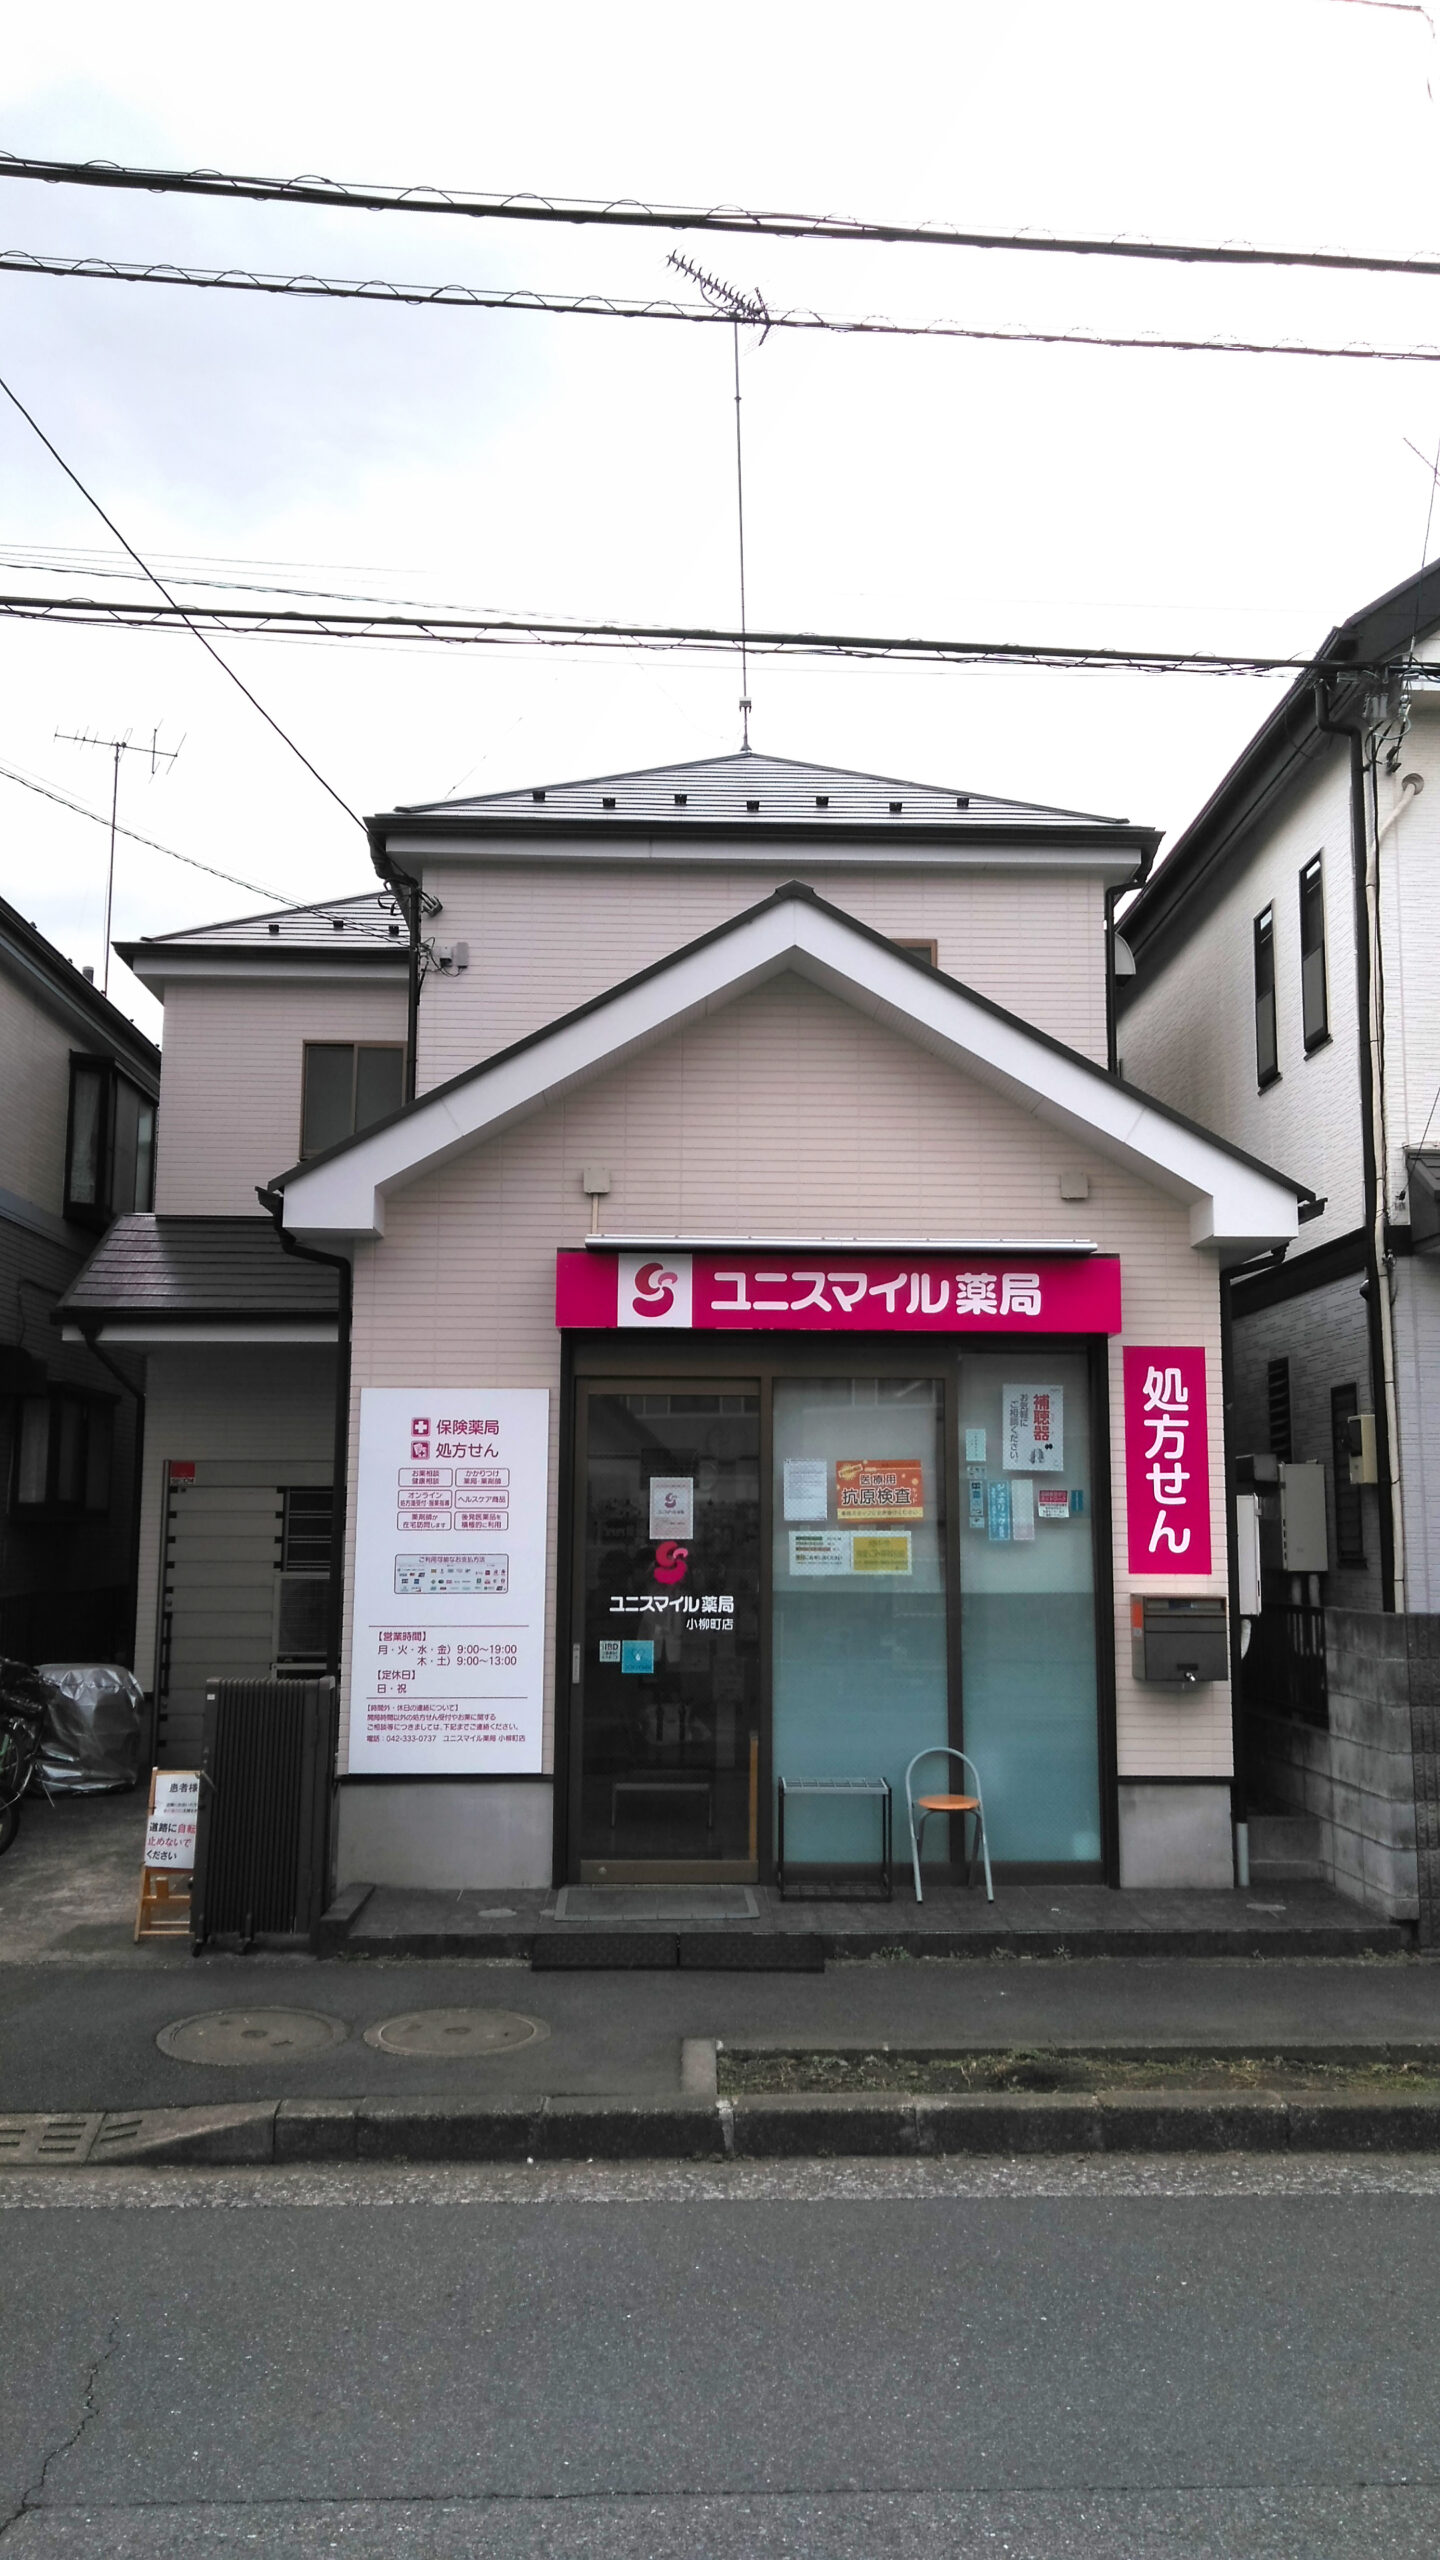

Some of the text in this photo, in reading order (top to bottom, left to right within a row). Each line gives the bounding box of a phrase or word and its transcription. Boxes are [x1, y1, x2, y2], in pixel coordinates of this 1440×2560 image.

[711, 1273, 1041, 1315] ユニスマイル薬局
[1033, 1394, 1050, 1441] 補聴器
[437, 1420, 499, 1435] 保険薬局
[436, 1442, 498, 1458] 処方せん
[1143, 1366, 1190, 1553] 処方せん
[860, 1474, 897, 1486] 医療用
[408, 1492, 442, 1500] オンライン
[458, 1496, 506, 1504] ヘルスケア商品
[842, 1487, 911, 1505] 抗原検査
[610, 1596, 734, 1613] ユニスマイル薬局
[687, 1618, 733, 1630] 小柳町店
[379, 1631, 426, 1641] 【営業時間】
[378, 1670, 415, 1680] 【定休日】
[378, 1684, 406, 1693] 日・祝
[146, 1850, 177, 1861] ください
